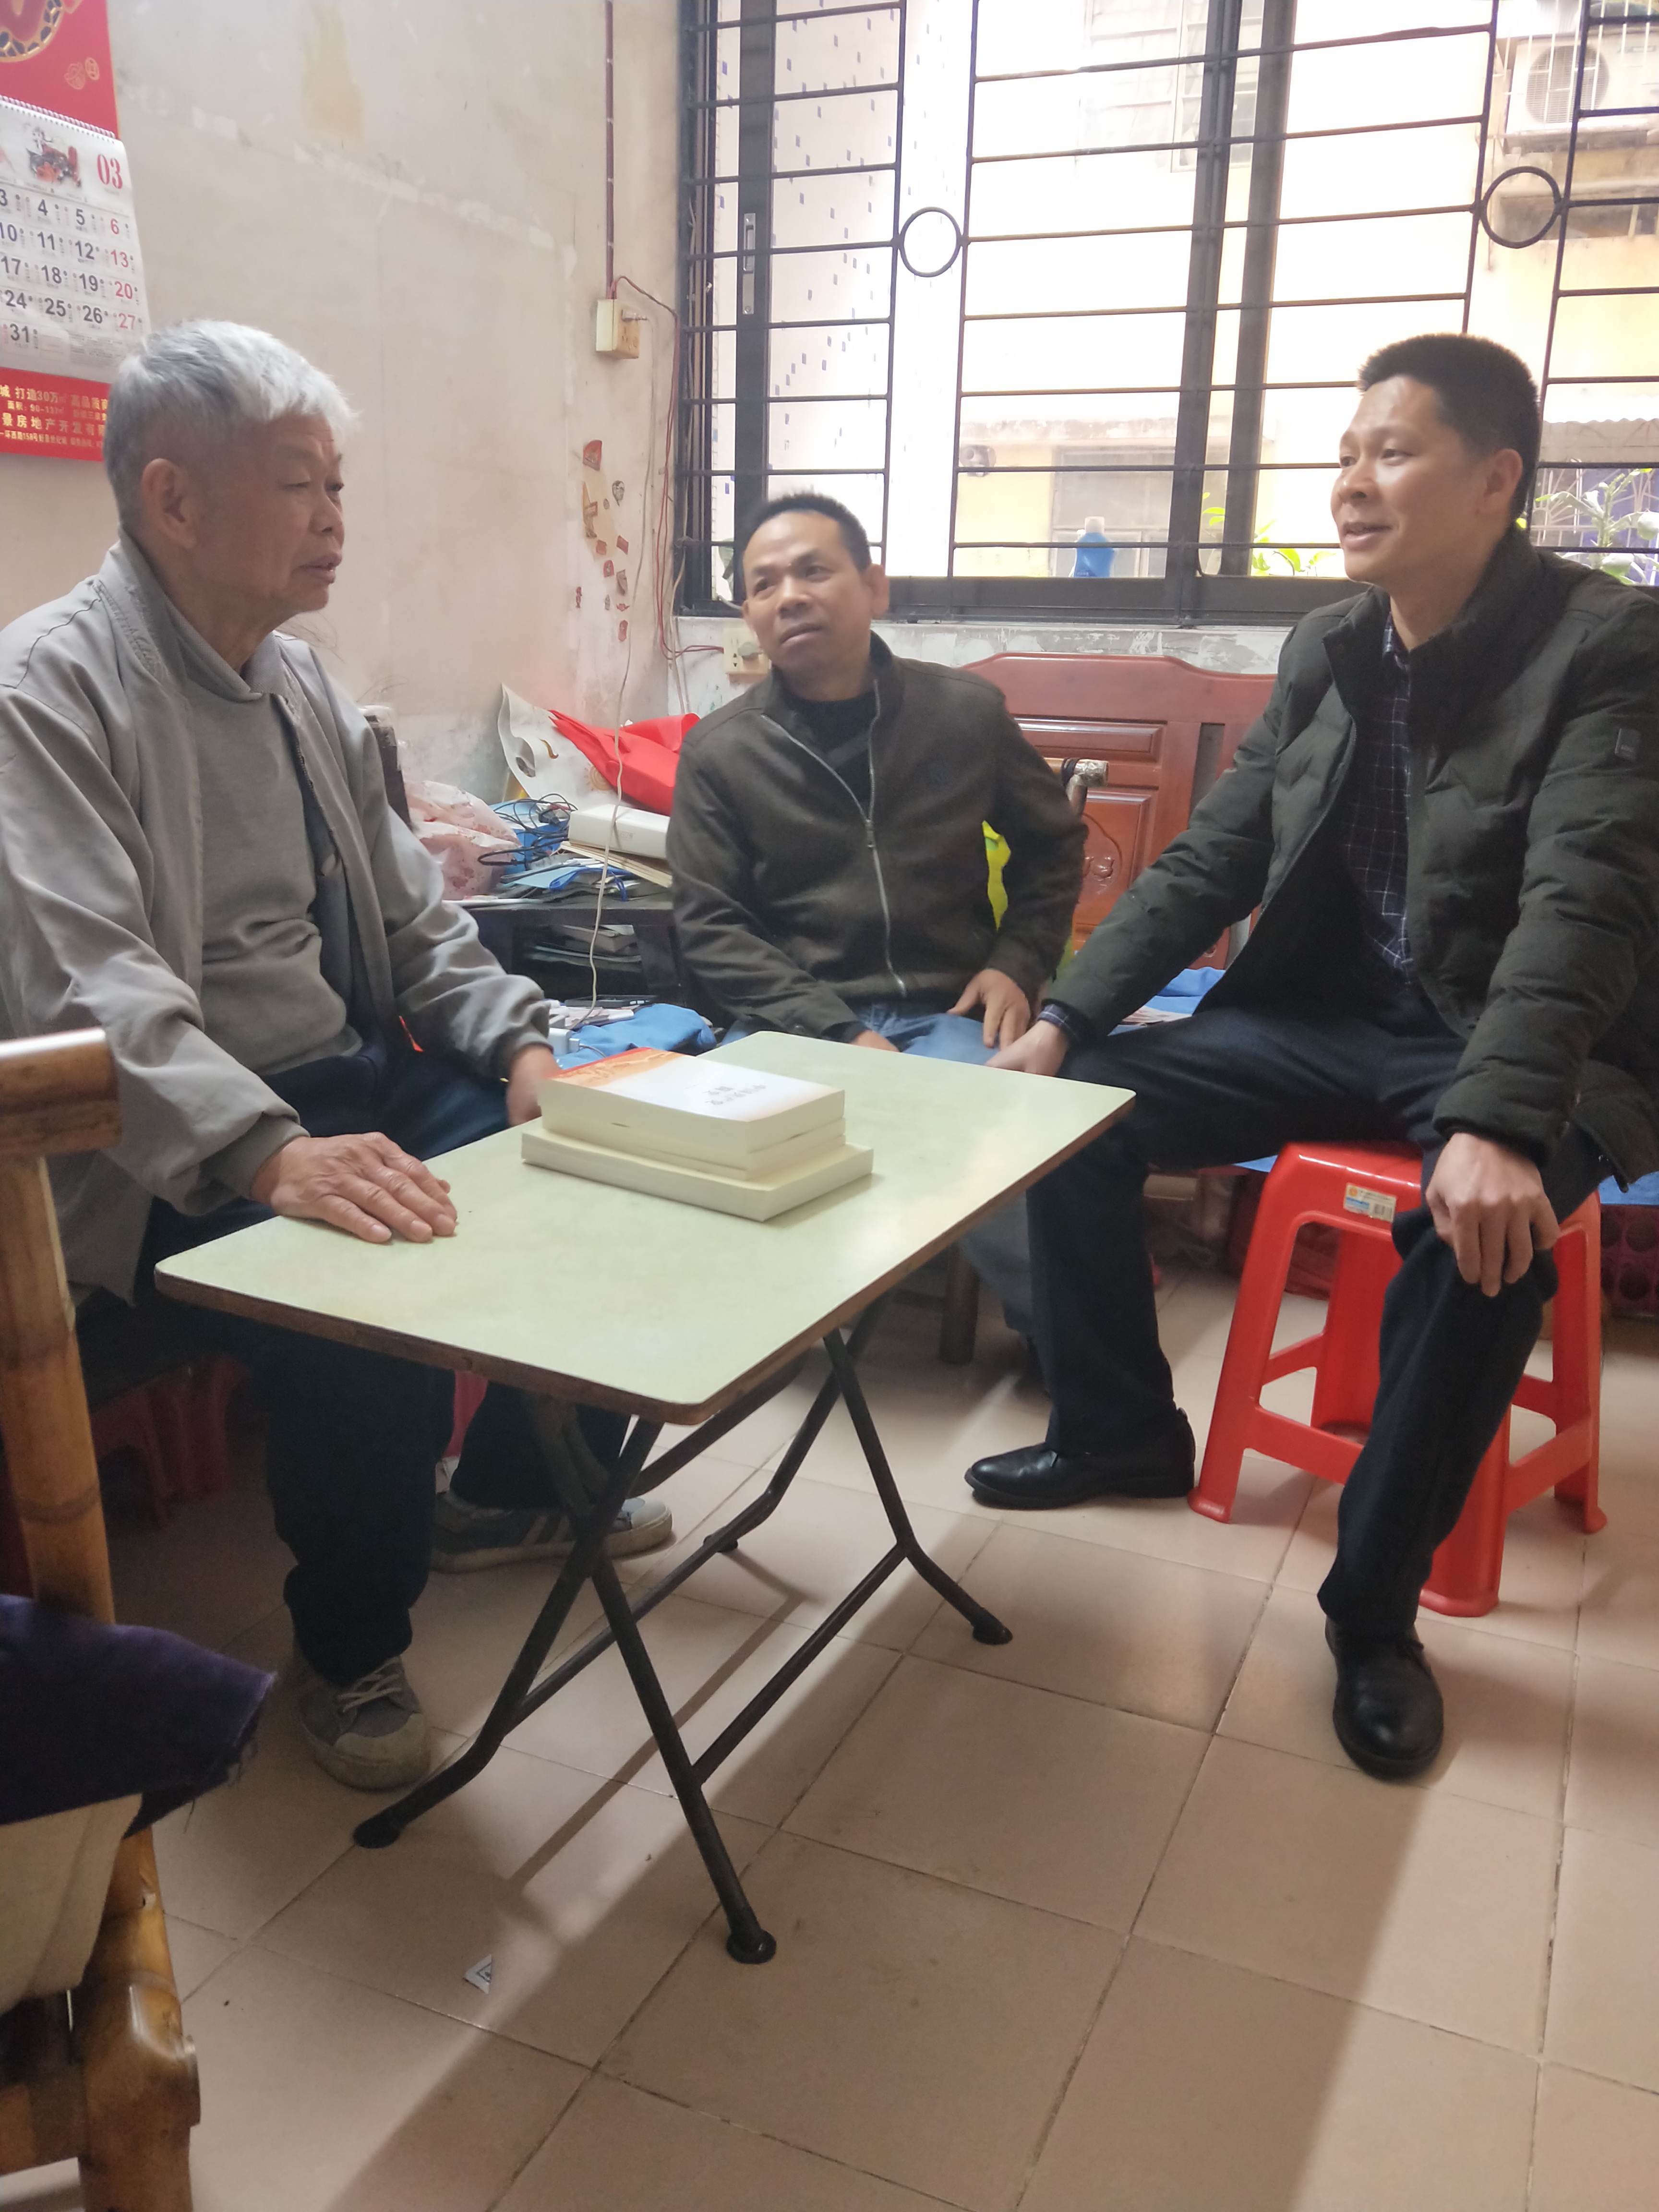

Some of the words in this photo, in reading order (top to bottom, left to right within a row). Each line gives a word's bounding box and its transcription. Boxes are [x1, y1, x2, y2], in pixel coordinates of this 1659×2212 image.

[96, 154, 123, 189] 03
[38, 199, 48, 216] 4
[76, 208, 85, 225] 5
[110, 218, 119, 234] 6
[0, 222, 17, 241] 10
[37, 231, 55, 250] 11
[75, 240, 95, 260] 12
[111, 250, 129, 267] 13
[1, 256, 21, 275] 17
[41, 265, 62, 284] 18
[79, 273, 98, 291] 19
[114, 281, 132, 299] 20
[5, 289, 27, 309] 24
[45, 298, 66, 317] 25
[83, 305, 103, 324] 26
[119, 313, 135, 330] 27
[10, 324, 29, 343] 31
